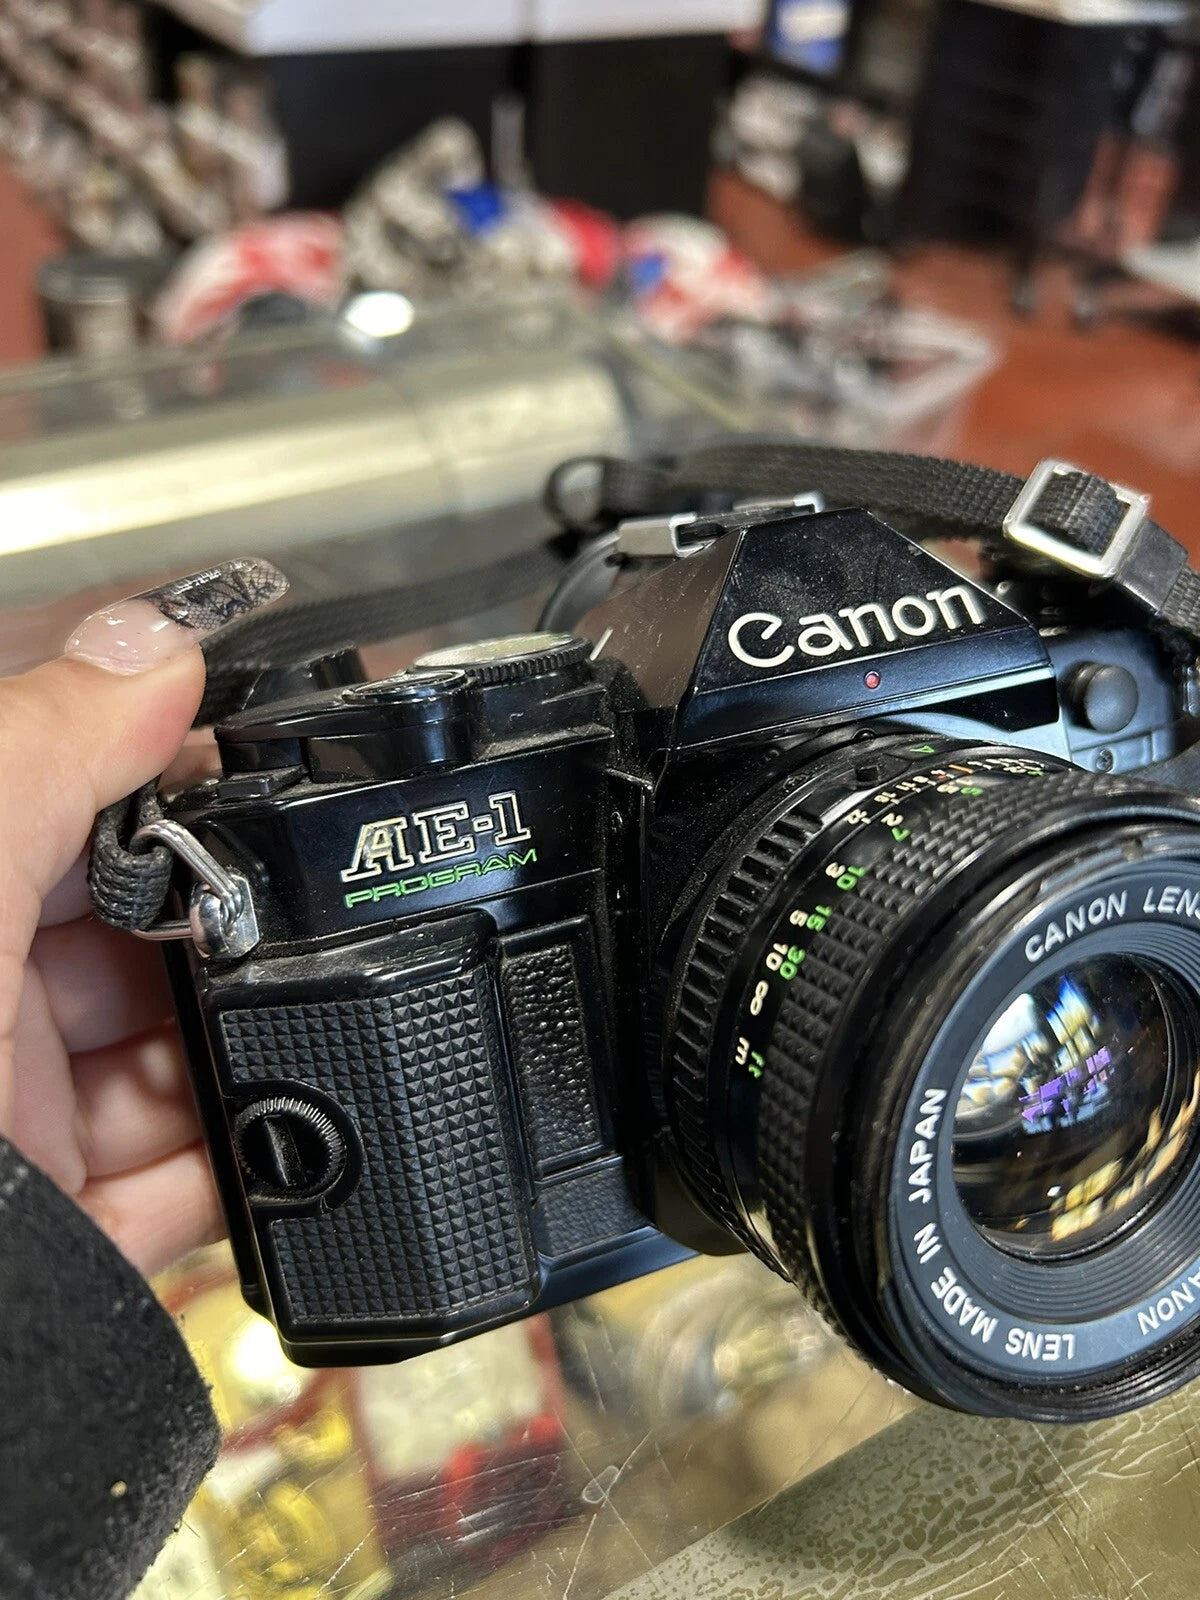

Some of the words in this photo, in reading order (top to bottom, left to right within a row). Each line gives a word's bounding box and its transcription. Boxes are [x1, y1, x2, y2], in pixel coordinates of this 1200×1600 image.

[727, 585, 987, 668] Canon
[340, 790, 532, 883] AE-1
[891, 826, 911, 842] 7
[345, 848, 539, 909] PROGRAM
[825, 861, 846, 879] 3
[836, 864, 867, 891] 10
[789, 909, 809, 928] 5
[806, 904, 833, 932] 15
[1024, 889, 1129, 964] CANON
[765, 942, 789, 971] 10
[779, 944, 806, 981] 30
[908, 1088, 948, 1204] JAPAN
[913, 1222, 943, 1264] IN
[930, 1266, 999, 1344] MADE
[1005, 1327, 1077, 1361] LENS
